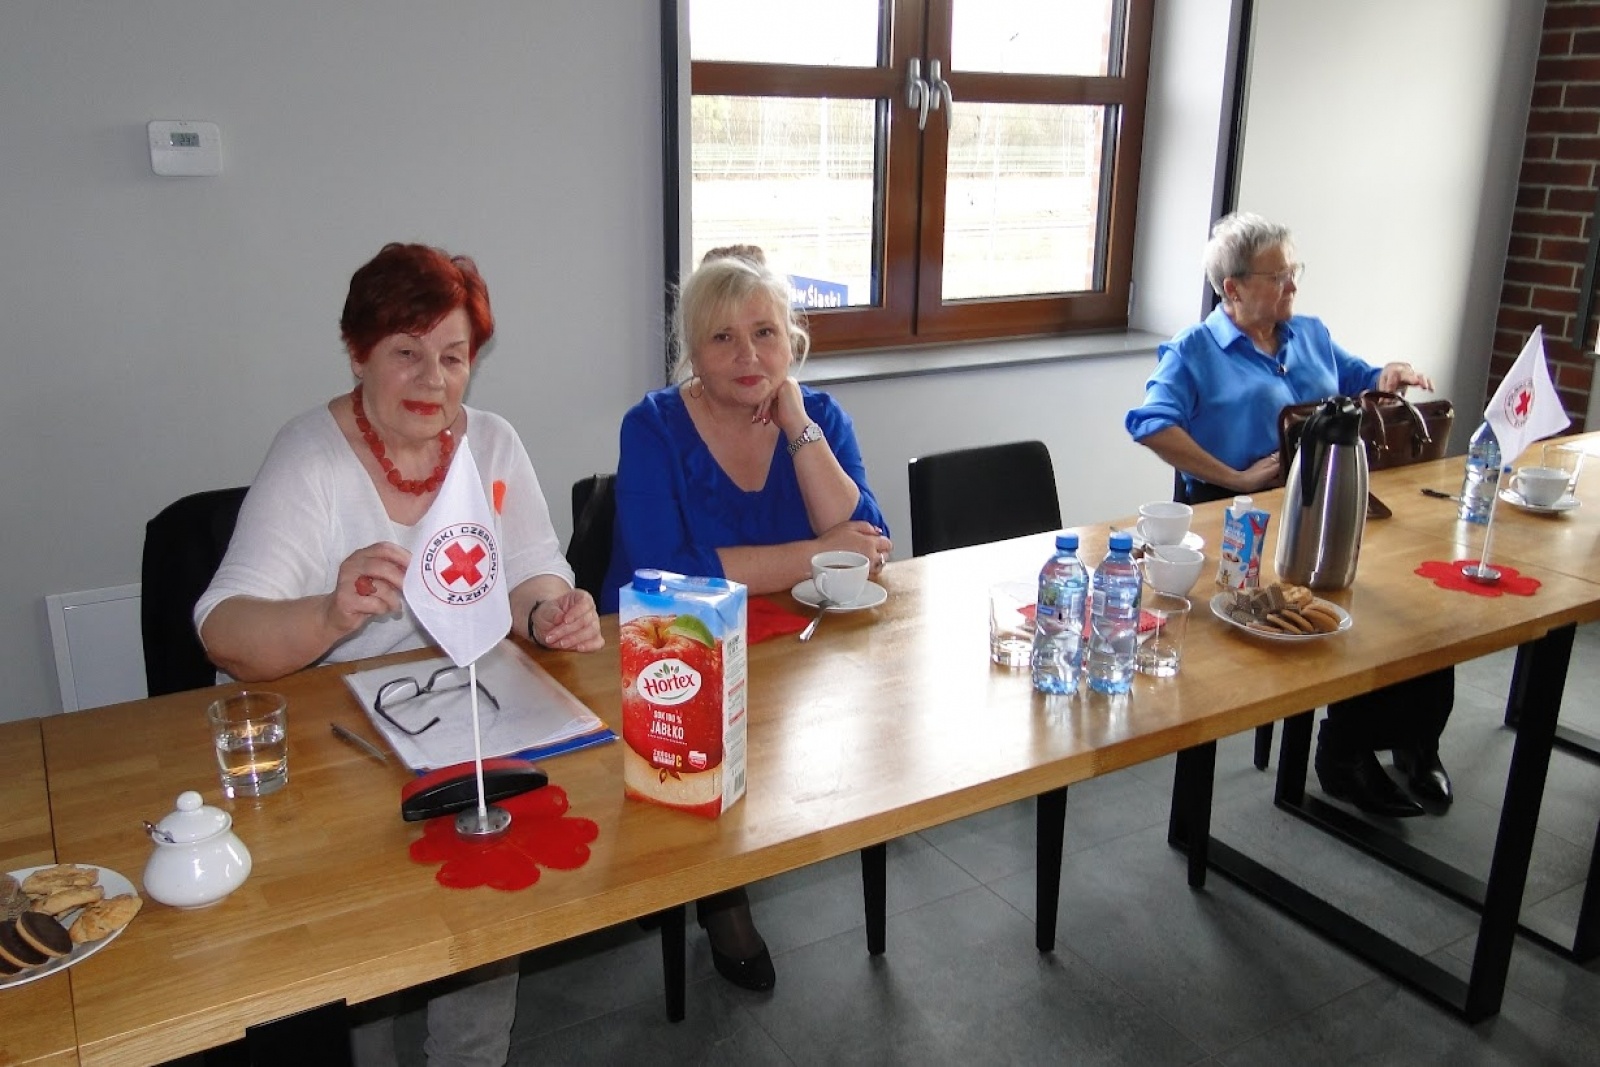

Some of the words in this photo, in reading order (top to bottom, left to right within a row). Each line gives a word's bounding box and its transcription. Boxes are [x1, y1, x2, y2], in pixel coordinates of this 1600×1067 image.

[424, 530, 454, 571] POLSKI
[461, 526, 497, 581] CZERWONY
[643, 674, 696, 697] Hortex
[650, 720, 684, 740] JABŁKO
